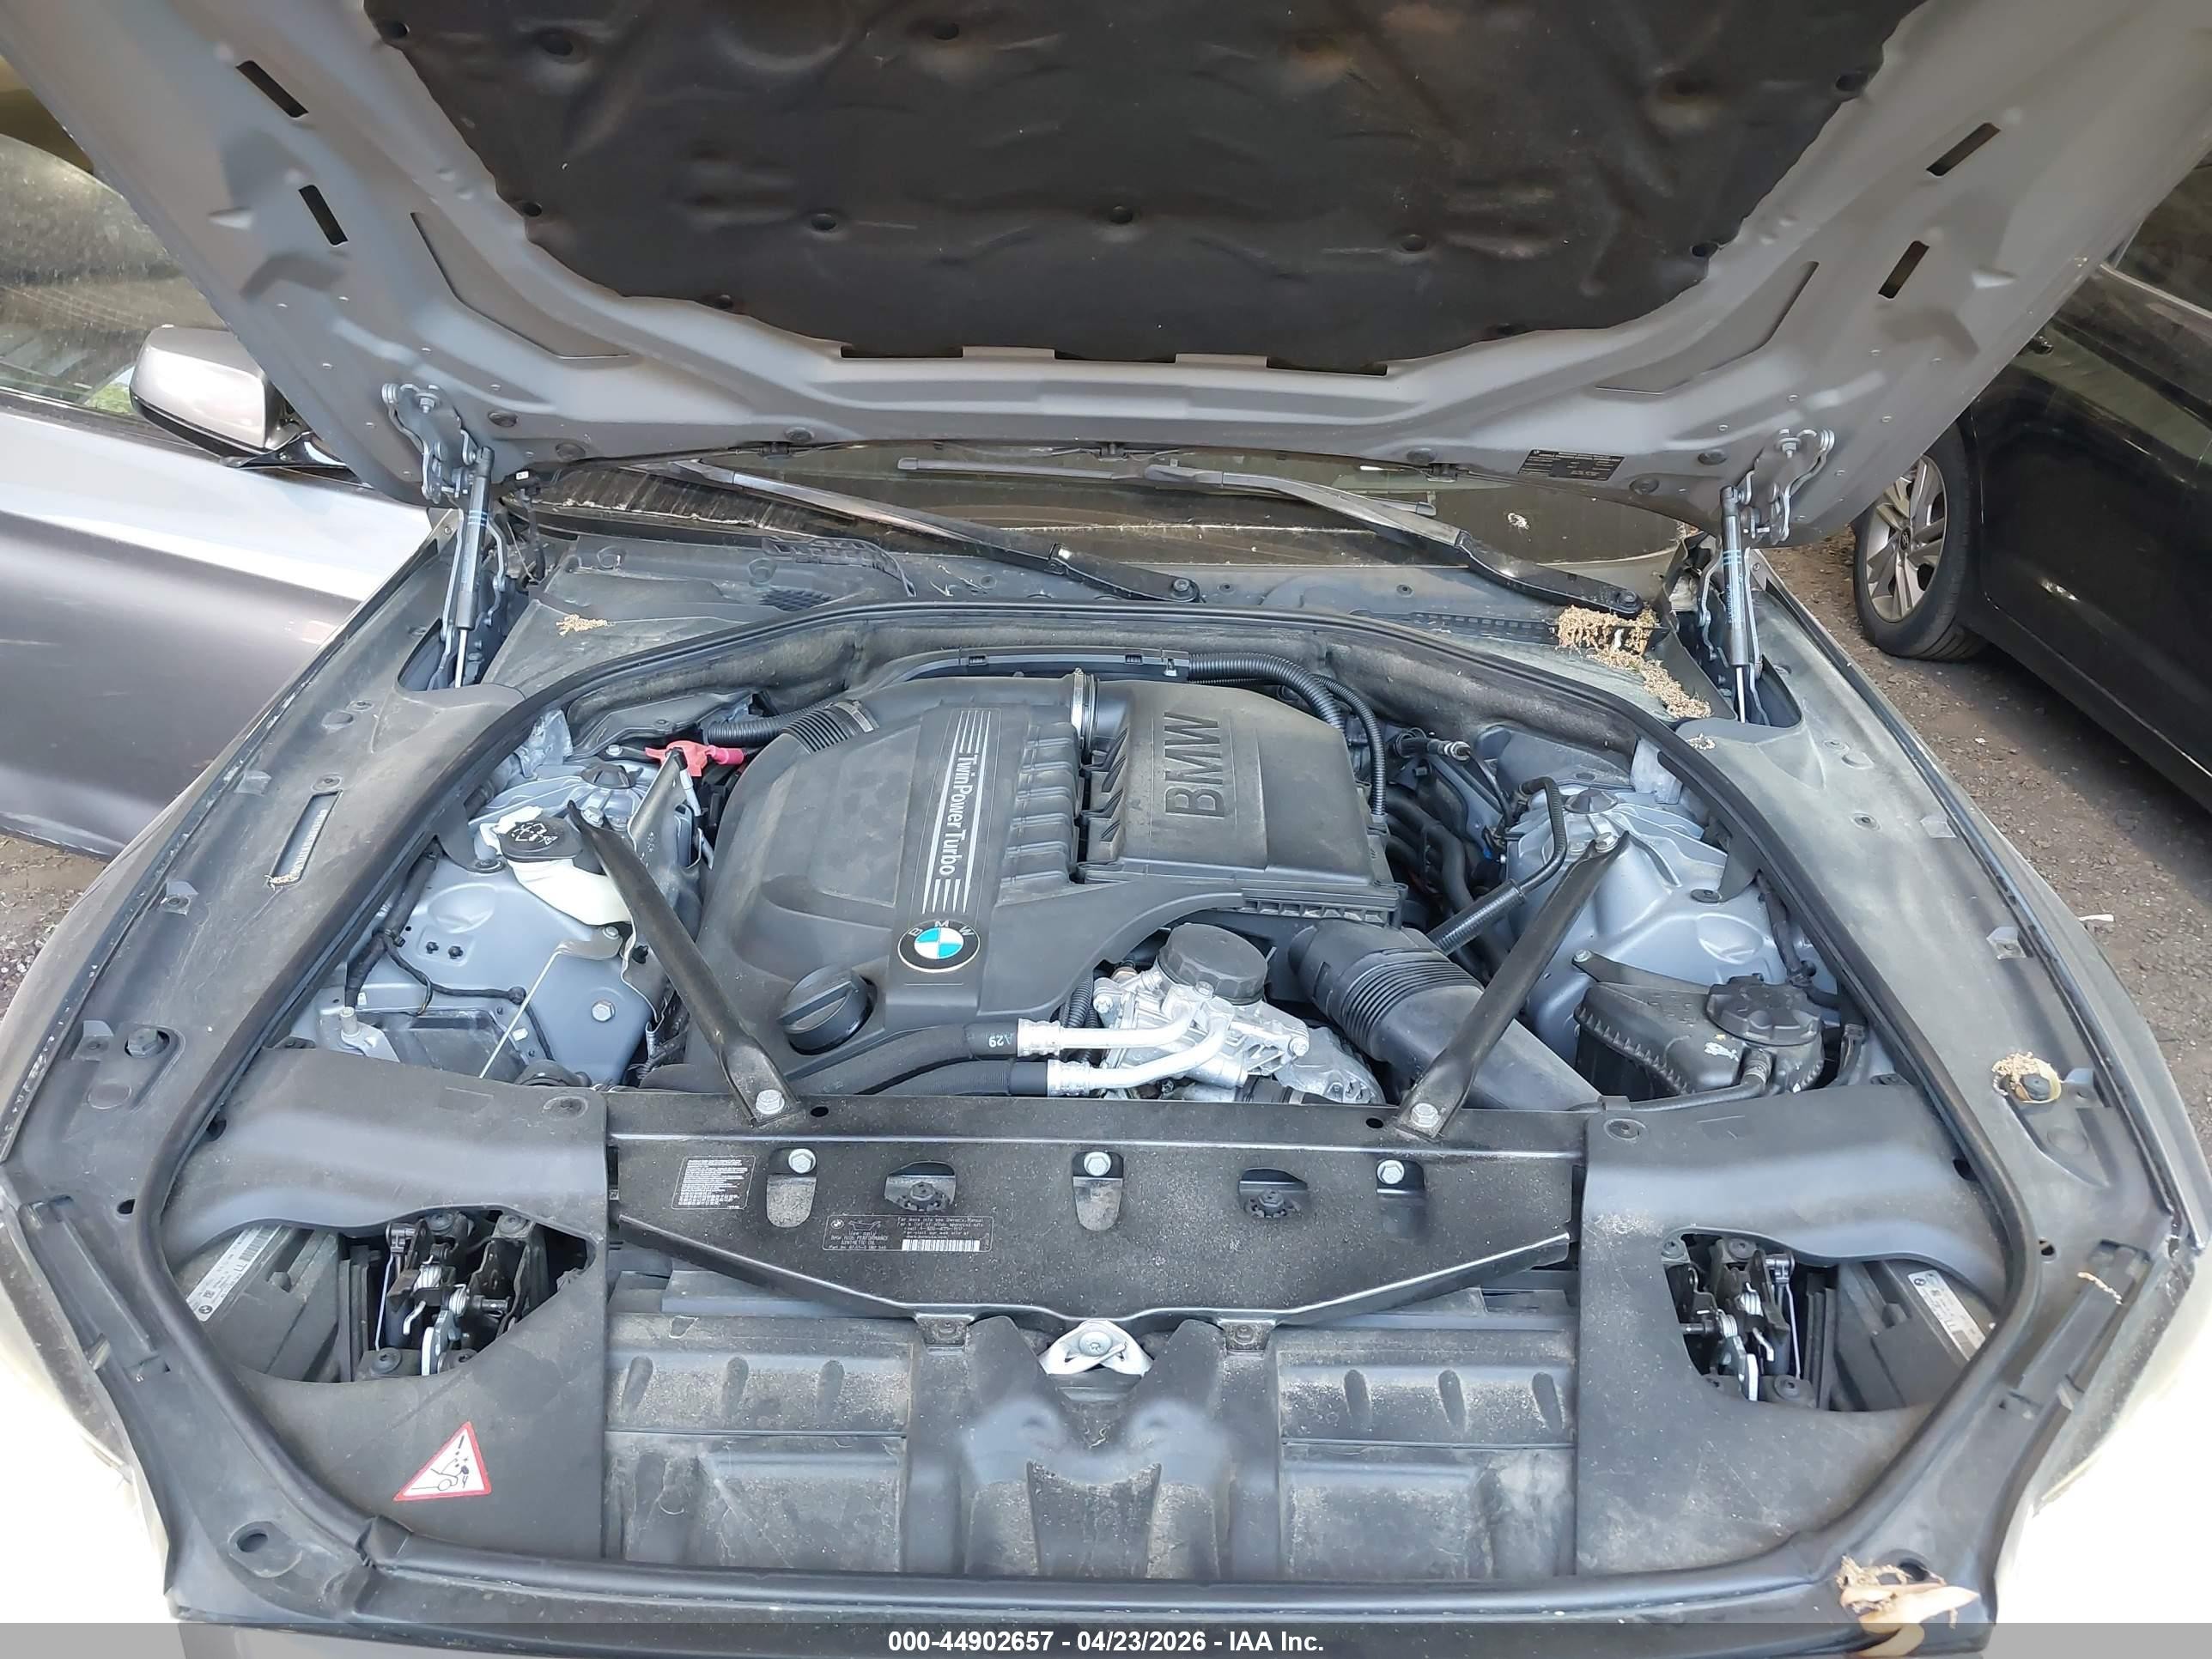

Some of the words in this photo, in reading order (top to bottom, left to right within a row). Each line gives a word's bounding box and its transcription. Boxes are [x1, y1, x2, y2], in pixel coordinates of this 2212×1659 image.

[1164, 712, 1224, 818] BMW
[939, 829, 967, 876] Turbo
[908, 920, 975, 937] BMW
